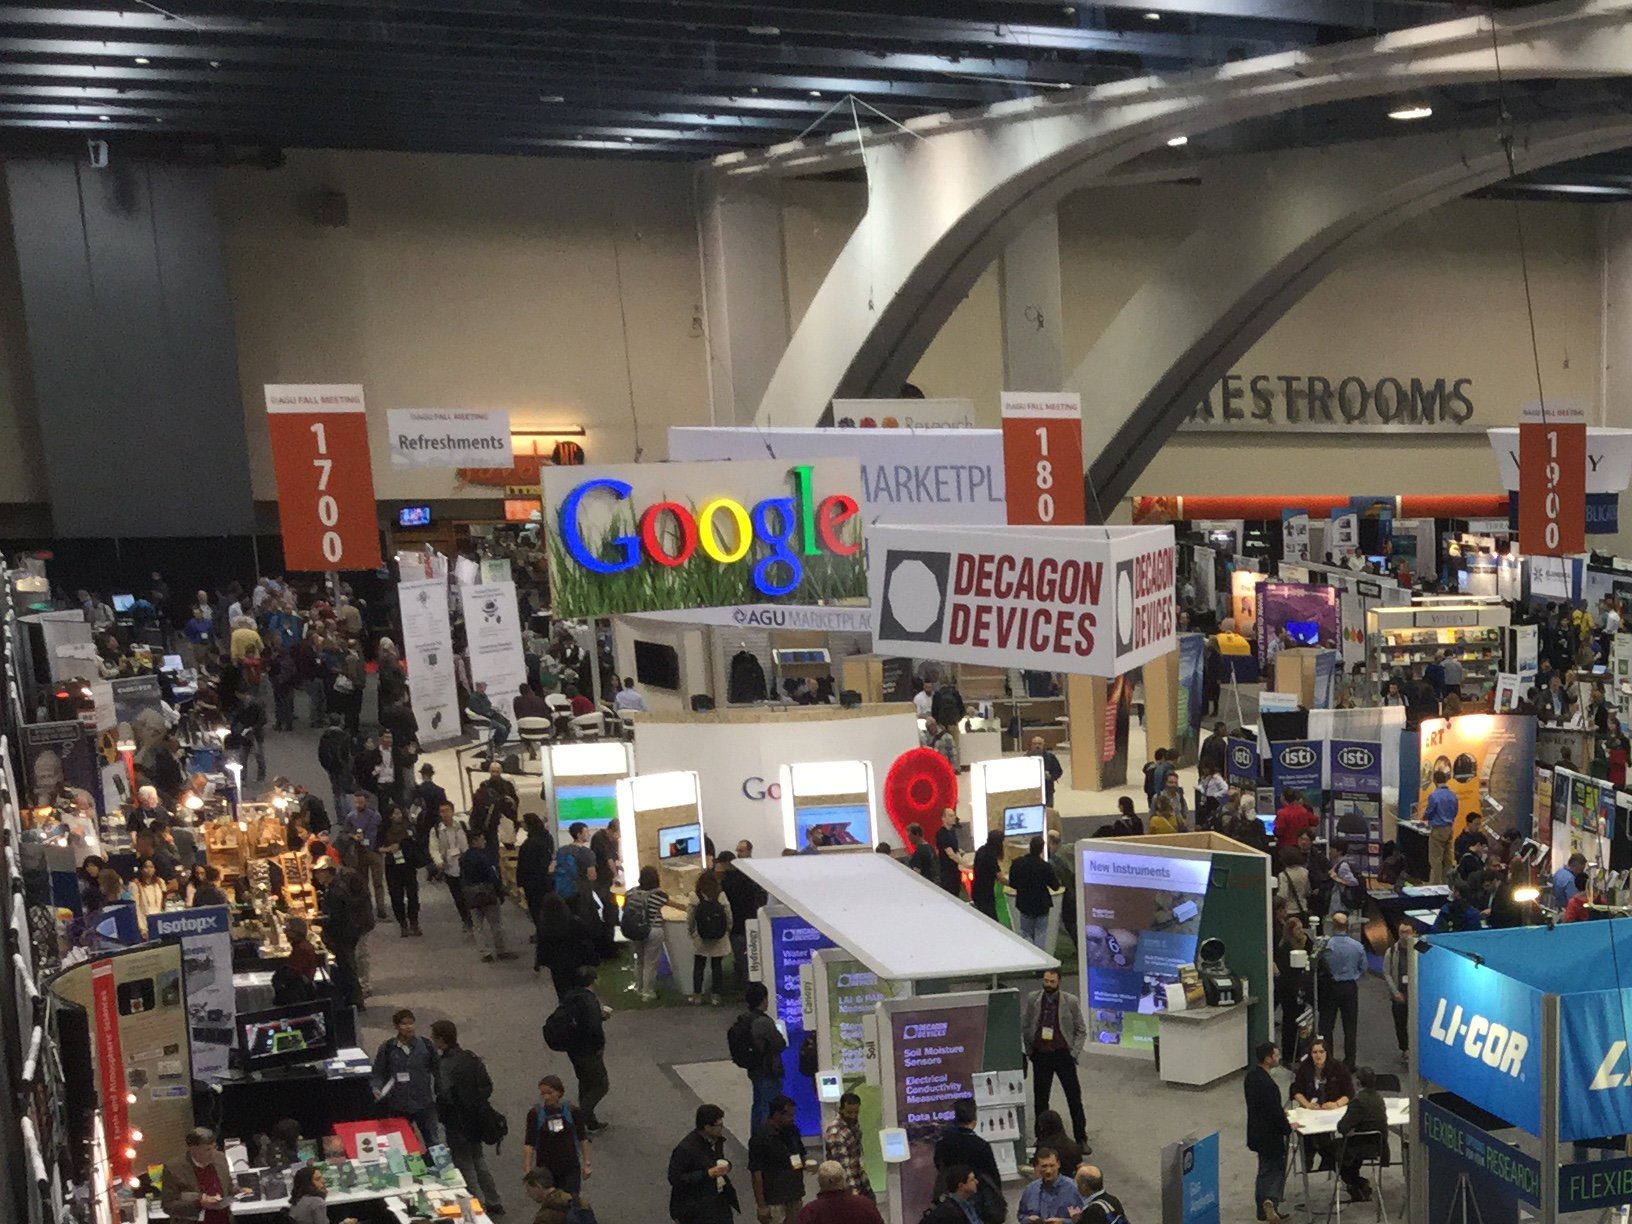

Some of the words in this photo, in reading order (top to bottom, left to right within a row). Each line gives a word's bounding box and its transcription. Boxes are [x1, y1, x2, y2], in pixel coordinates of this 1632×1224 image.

[298, 396, 319, 405] FALL
[321, 396, 360, 405] MEETING
[1027, 403, 1044, 411] FALL
[1045, 403, 1078, 411] MEETING
[399, 433, 505, 451] Refreshments
[310, 422, 343, 562] 1700
[1544, 431, 1560, 550] 1900
[559, 464, 861, 596] Google
[953, 552, 1104, 606] DECAGON
[1135, 546, 1175, 600] DECAGON
[748, 610, 786, 627] AGU
[1135, 593, 1173, 650] DEVICES
[1431, 614, 1465, 623] WILEY
[949, 602, 1097, 657] DEVICES
[1284, 747, 1311, 764] isti
[1342, 747, 1369, 765] isti
[1090, 860, 1110, 873] New
[1112, 863, 1171, 879] Instruments
[157, 915, 218, 934] Isotopx
[749, 930, 760, 972] Hydrology
[804, 981, 814, 1015] Canopy
[1430, 997, 1529, 1079] LI-COR
[865, 1040, 876, 1060] Soil
[904, 1048, 922, 1058] Soil
[924, 1045, 965, 1056] Moisture
[103, 1034, 117, 1093] Atmospheric
[904, 1056, 942, 1068] Sensors
[906, 1073, 948, 1086] Electrical
[906, 1082, 962, 1095] Conductivity
[907, 1090, 973, 1104] Measurements
[908, 1112, 930, 1122] Data
[1424, 1111, 1464, 1156] FLEXIBLE
[1486, 1145, 1539, 1197] RESEARCH
